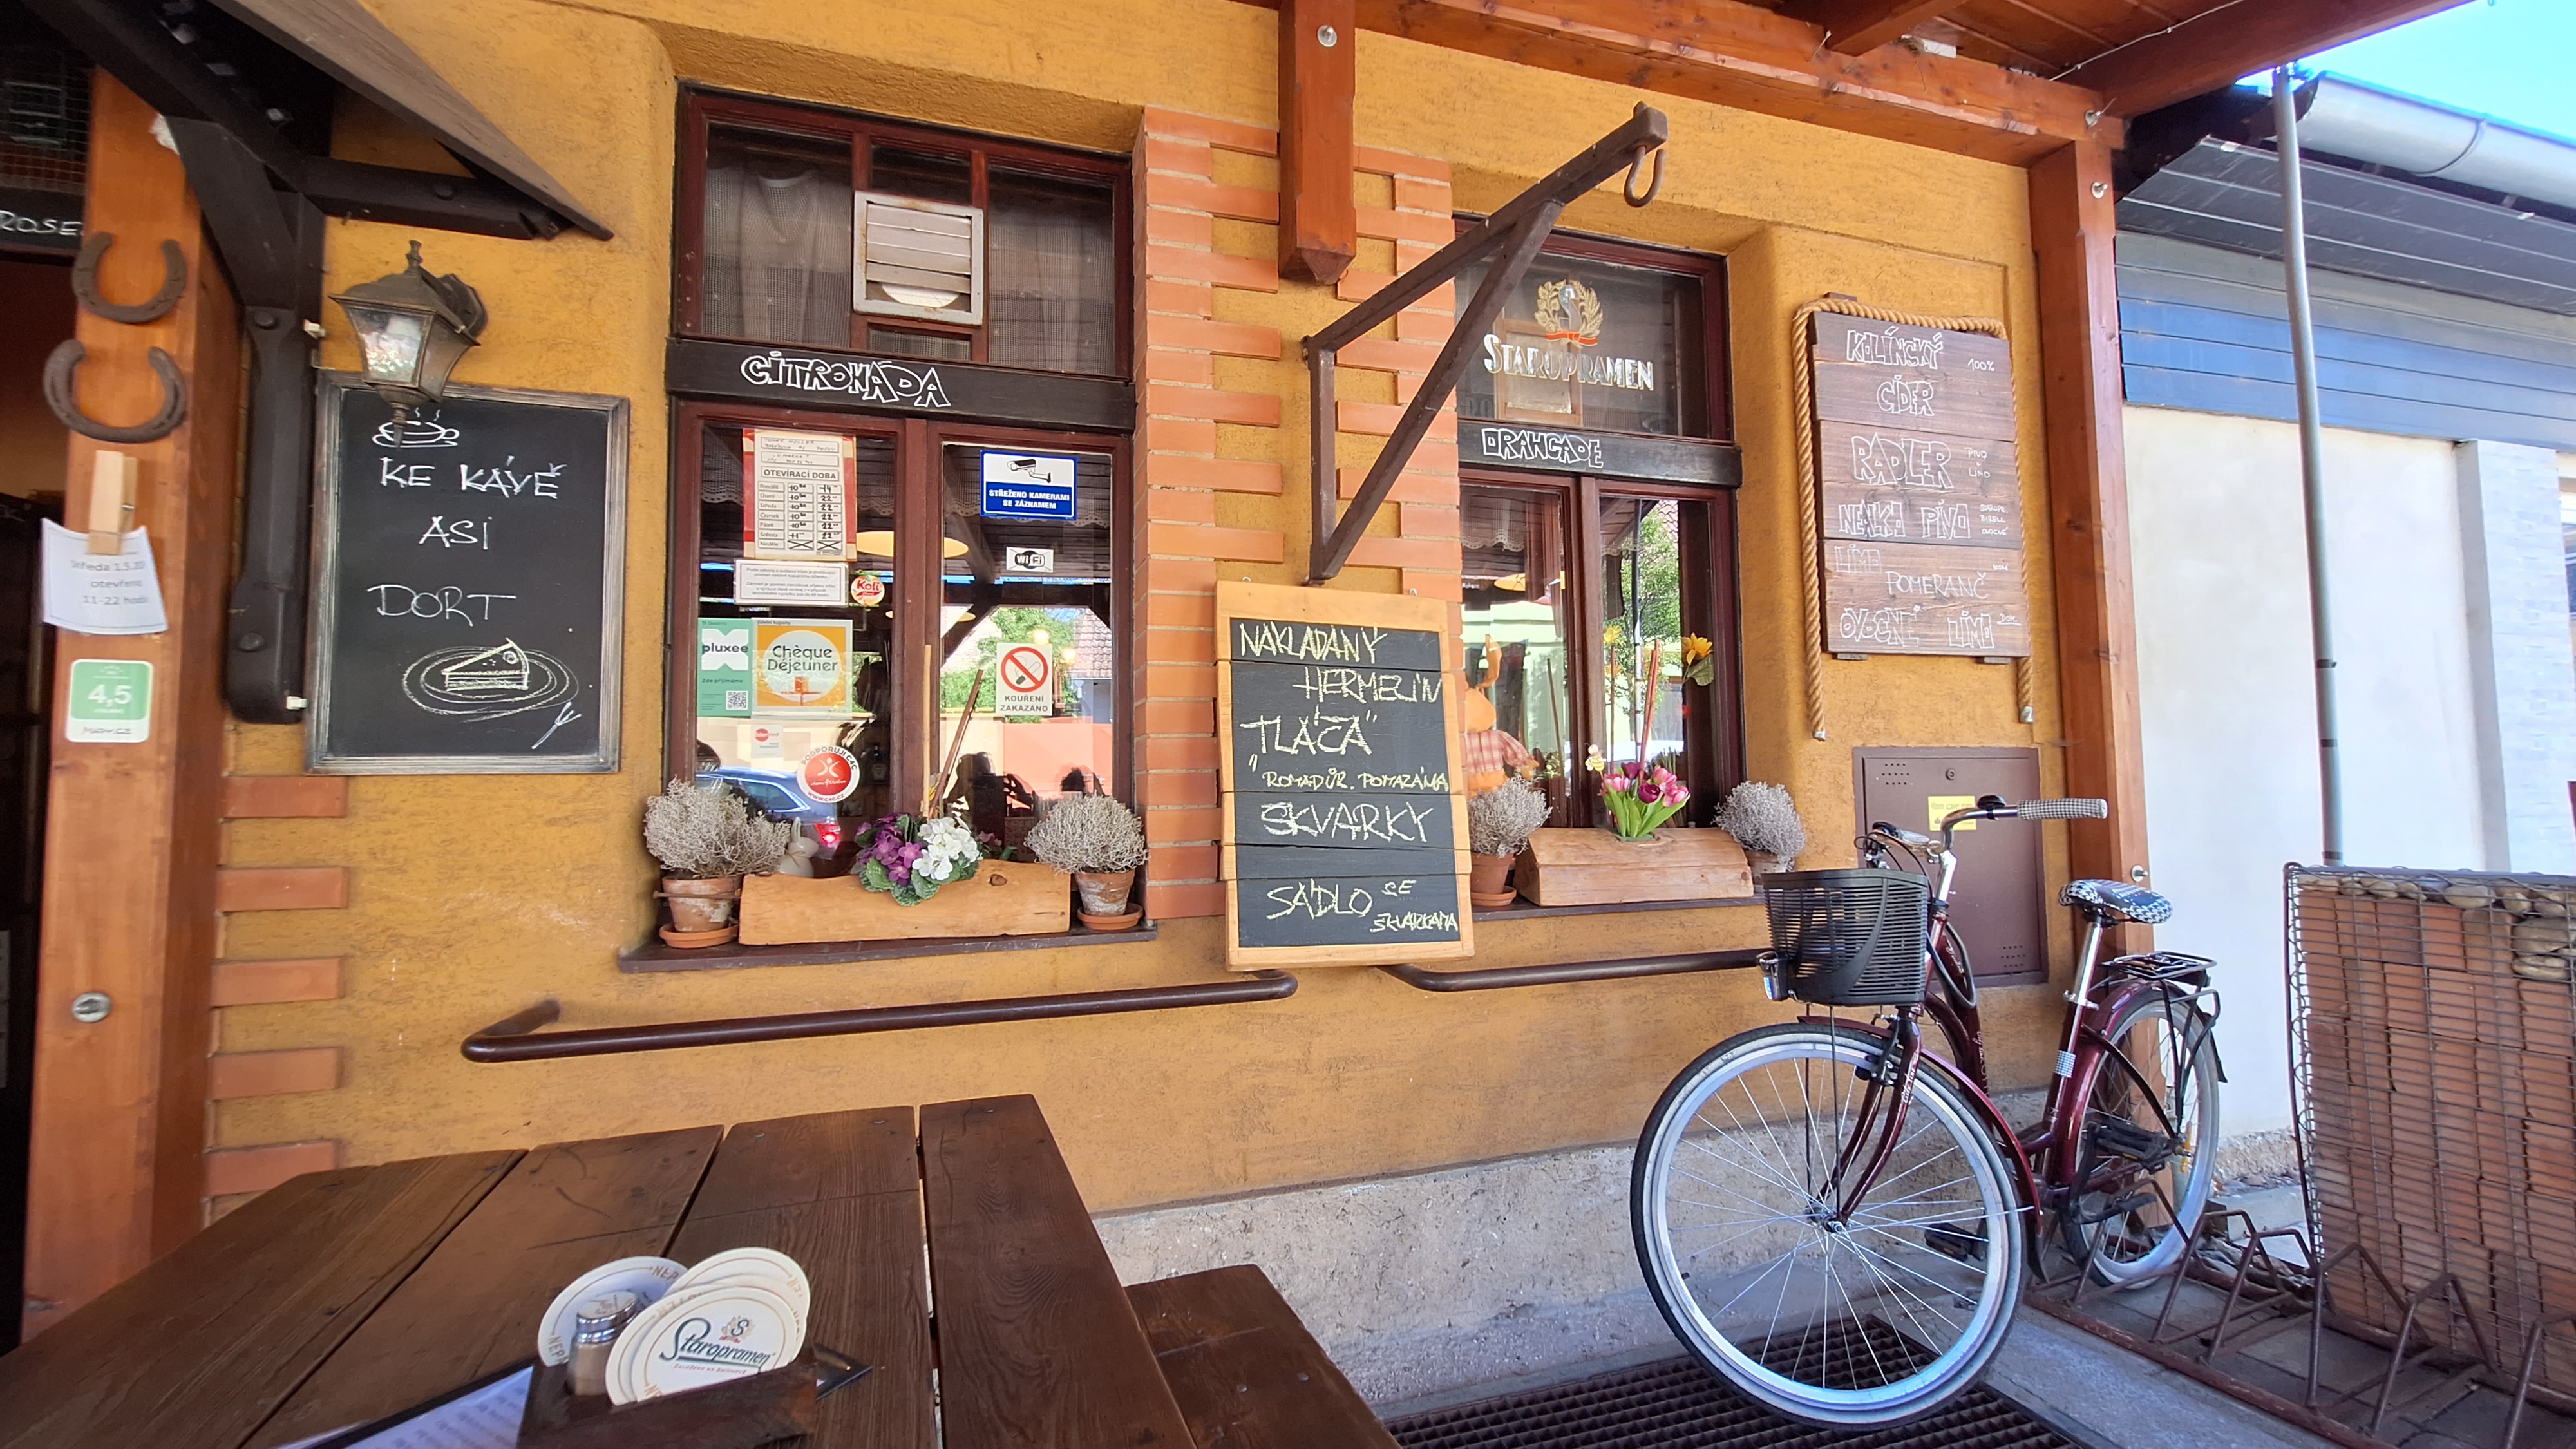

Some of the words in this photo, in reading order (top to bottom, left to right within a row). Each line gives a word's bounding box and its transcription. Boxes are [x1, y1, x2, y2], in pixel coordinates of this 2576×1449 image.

[1483, 333, 1654, 391] STAROPRAMEN
[1967, 358, 1995, 372] 100%
[1851, 432, 1954, 489] RADLER
[1965, 447, 1987, 459] PIVO
[380, 457, 435, 488] KE
[460, 455, 567, 499] KÁVĚ
[764, 469, 810, 478] OTEVÍRACÍ
[989, 488, 1027, 499] STŘEŽENO
[1029, 491, 1070, 501] KAMERAMI
[1014, 499, 1057, 509] ZÁZNAMEM
[1921, 499, 1970, 539] PIVO
[857, 580, 880, 591] Koli
[1886, 571, 1989, 599] POMERANČ
[367, 584, 516, 627] DORT
[702, 643, 749, 655] pluxee
[772, 645, 833, 660] Chèque
[768, 658, 838, 674] Déjeuner
[88, 684, 132, 707] 4,5
[801, 746, 846, 765] PODPORUJI
[846, 755, 857, 770] C4C
[659, 1318, 774, 1374] Staropramen
